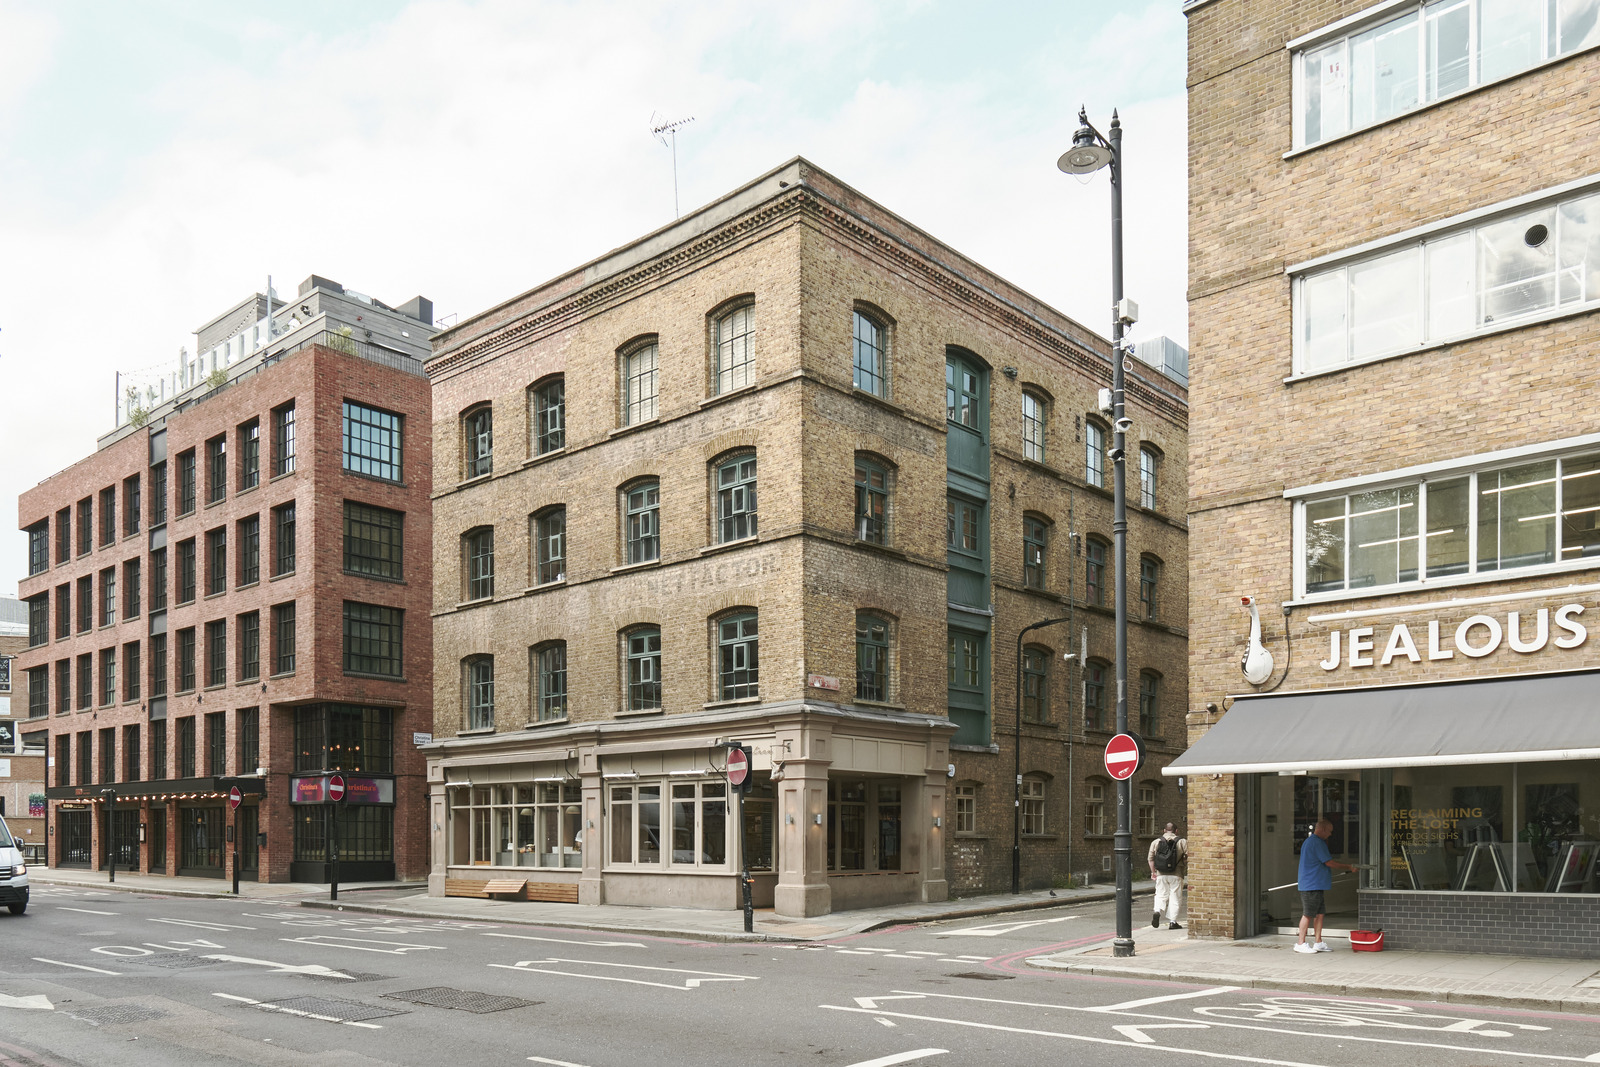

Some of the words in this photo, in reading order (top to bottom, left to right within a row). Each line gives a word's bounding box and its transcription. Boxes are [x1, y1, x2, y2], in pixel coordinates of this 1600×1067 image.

[1319, 603, 1588, 671] JEALOUS
[347, 784, 376, 792] hristina's
[1391, 807, 1483, 819] RECLAIMING
[1390, 819, 1417, 830] THE
[1422, 819, 1460, 830] LOST
[1391, 832, 1404, 840] MY
[1406, 832, 1428, 840] DOG
[1431, 831, 1459, 840] SIGHS
